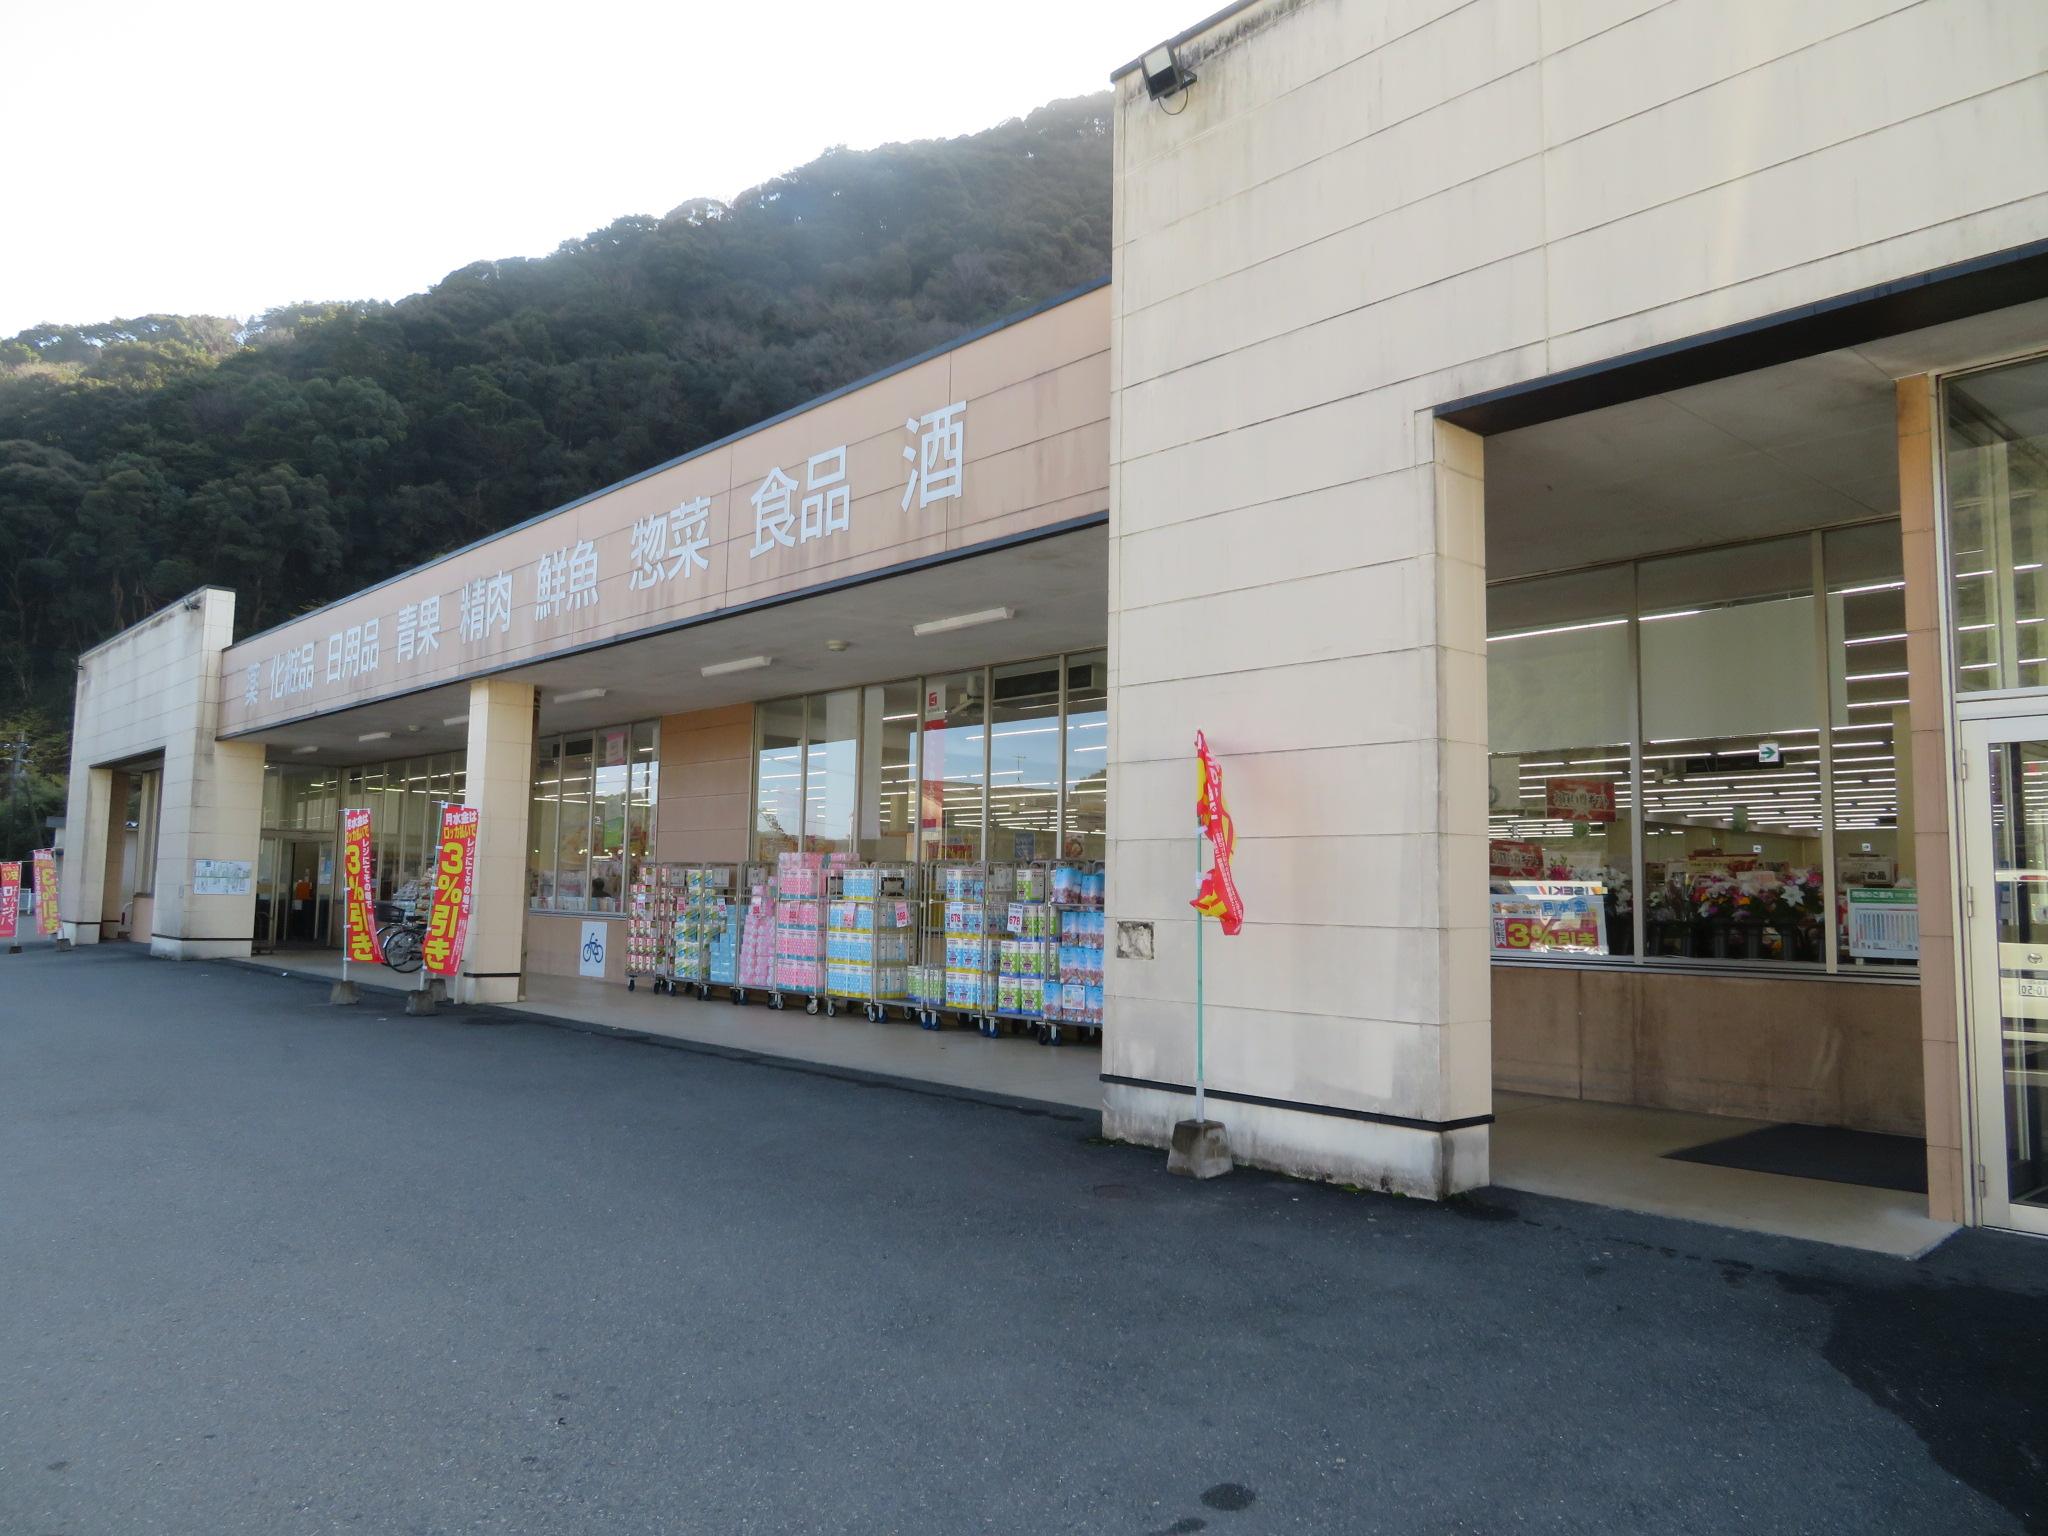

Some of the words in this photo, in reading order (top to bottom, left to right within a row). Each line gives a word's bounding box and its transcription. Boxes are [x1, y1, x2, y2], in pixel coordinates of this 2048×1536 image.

[244, 662, 261, 706] 薬
[270, 640, 315, 701] 化粧品
[326, 617, 380, 684] 日用品
[397, 595, 440, 664] 青果
[459, 569, 513, 644] 精肉
[534, 540, 599, 621] 鮮魚
[629, 496, 712, 591] 惣菜
[749, 444, 850, 559] 食品
[901, 400, 967, 512] 酒
[445, 811, 477, 825] 月水金は
[461, 838, 475, 914] レジにてその場で
[346, 844, 373, 961] 3%引き
[425, 842, 464, 970] 3%引き
